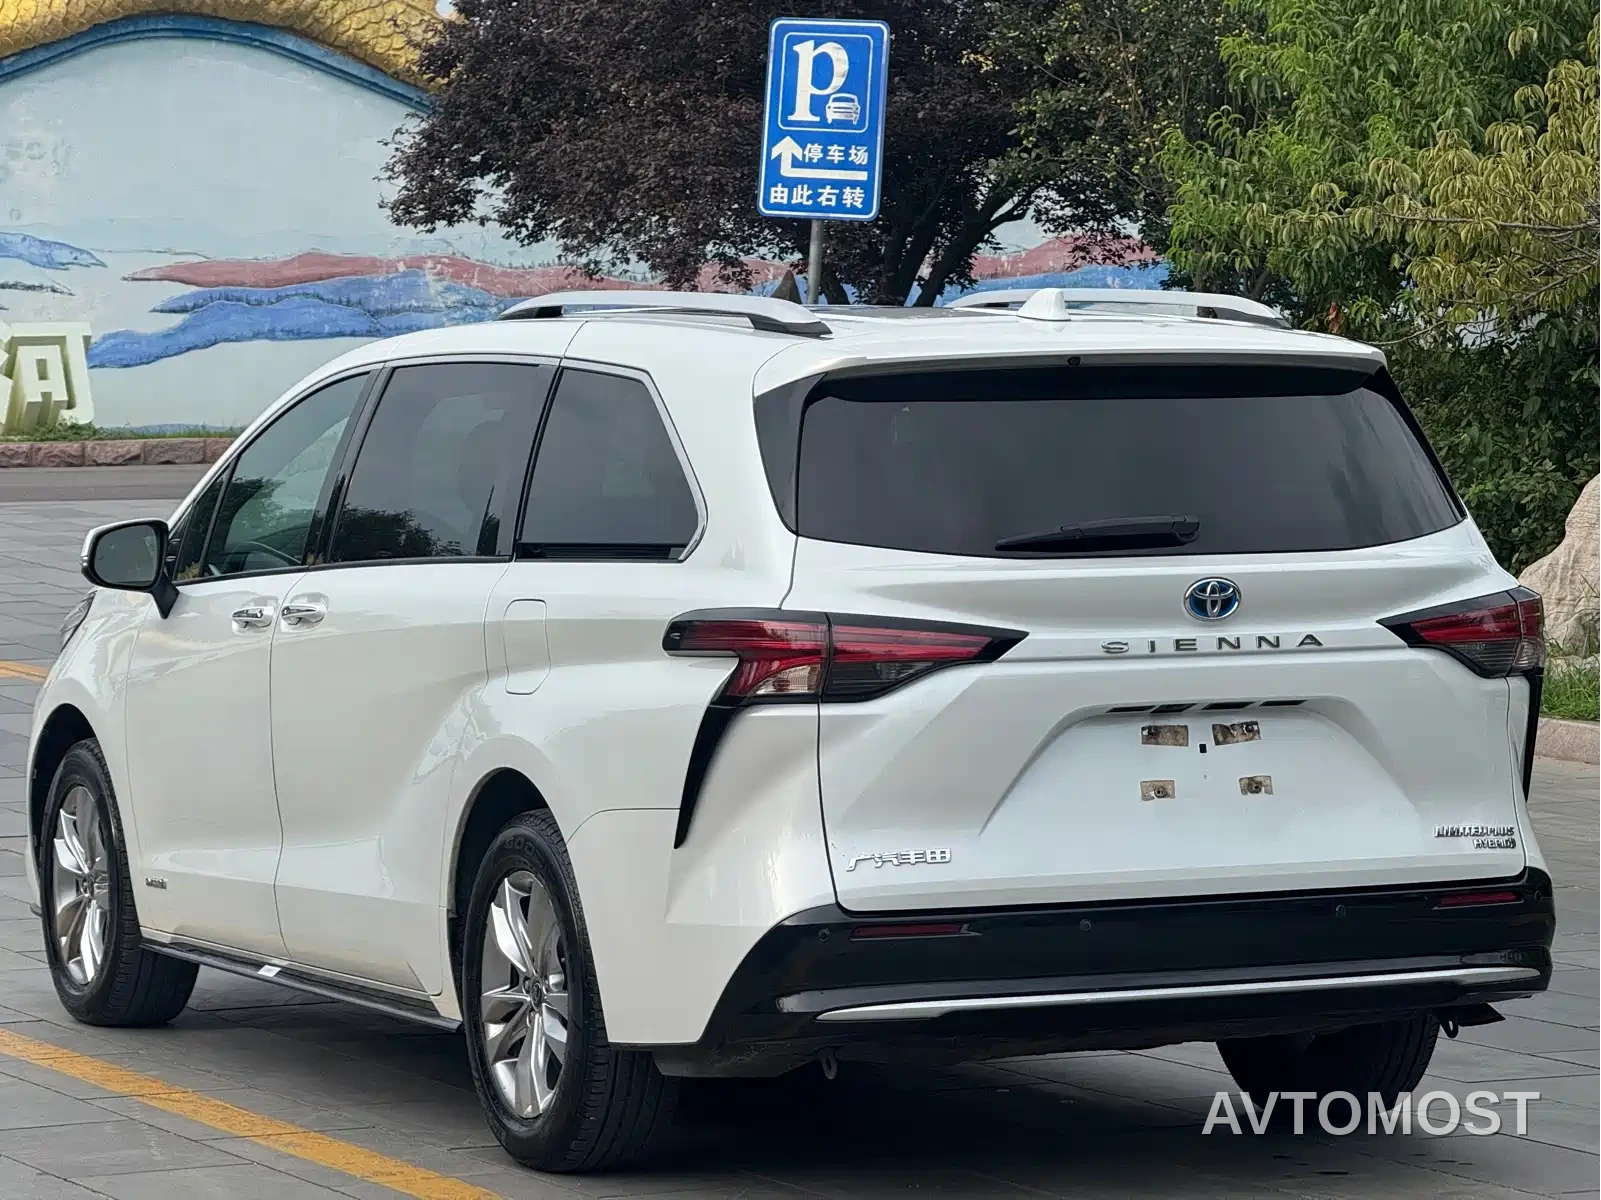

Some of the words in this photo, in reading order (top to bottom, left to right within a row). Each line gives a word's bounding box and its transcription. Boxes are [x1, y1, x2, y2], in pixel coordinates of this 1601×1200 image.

[804, 143, 868, 165] 停车场
[769, 183, 865, 208] 由此右转
[1101, 633, 1324, 654] SIENNA
[1472, 838, 1516, 849] HYBRID
[846, 848, 952, 872] 广汽丰田
